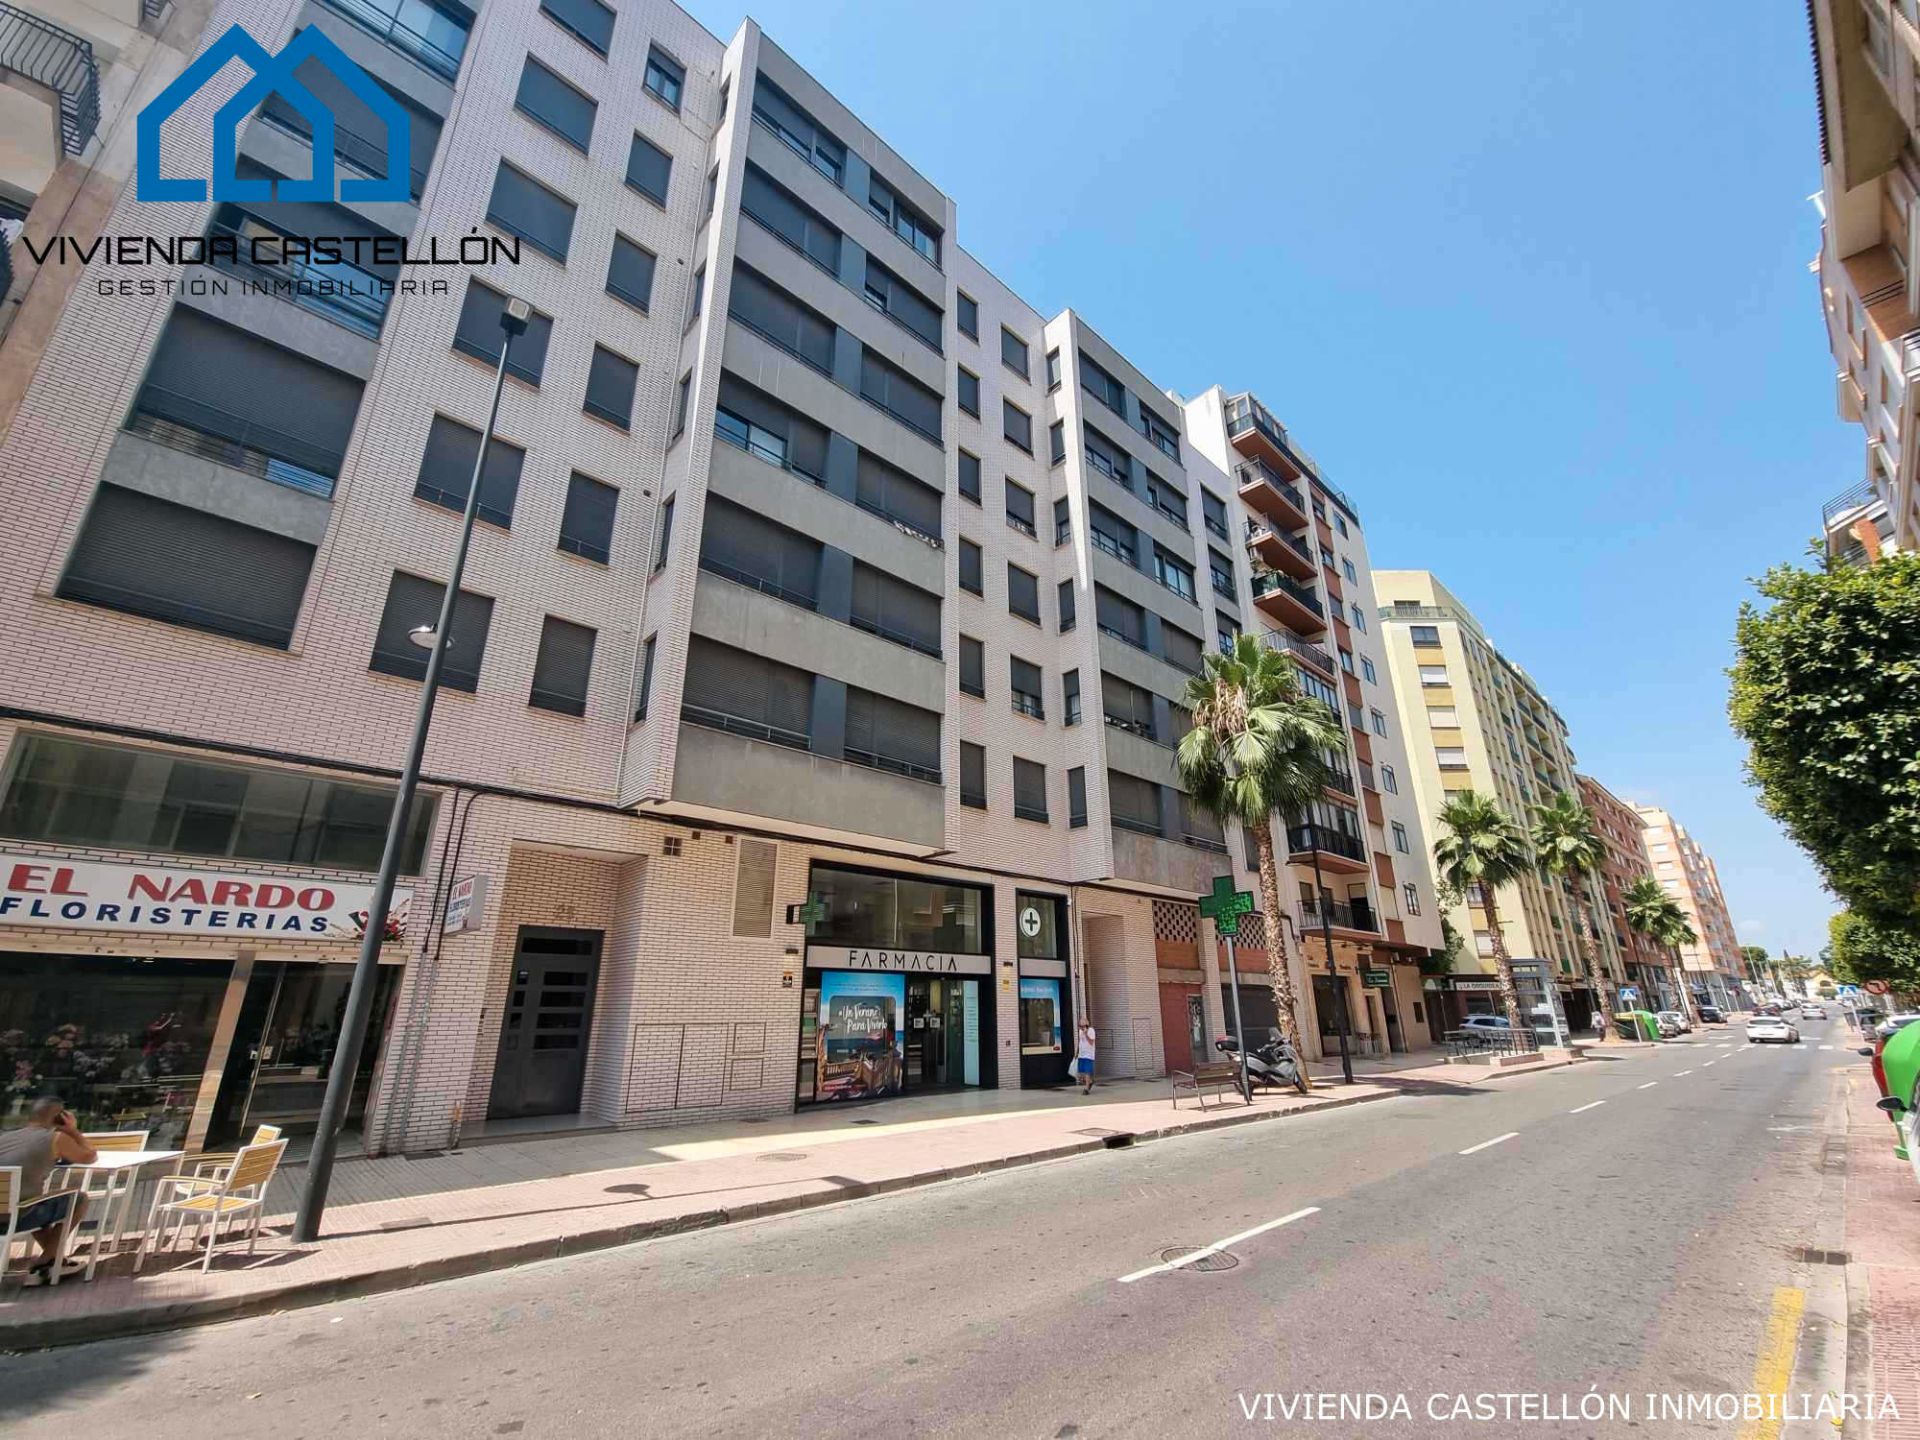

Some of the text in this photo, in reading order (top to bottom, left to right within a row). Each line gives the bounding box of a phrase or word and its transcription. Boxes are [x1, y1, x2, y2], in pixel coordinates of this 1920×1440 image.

[7, 863, 336, 912] EL NARDO
[0, 896, 329, 932] FLORISTERIAS
[849, 949, 958, 972] FARMACIA
